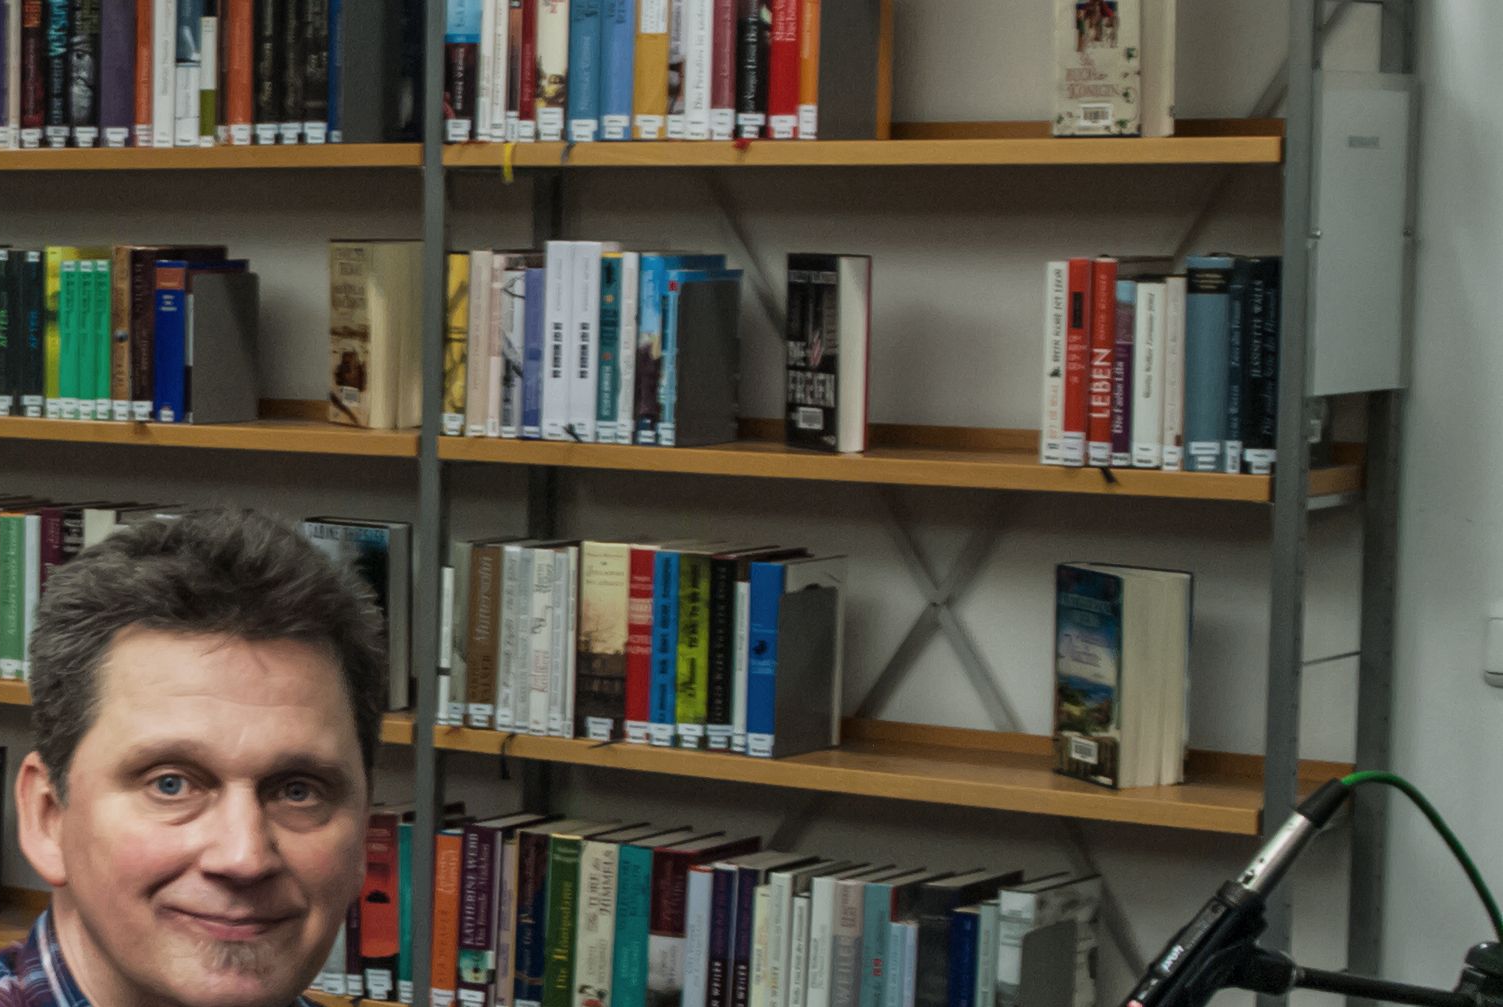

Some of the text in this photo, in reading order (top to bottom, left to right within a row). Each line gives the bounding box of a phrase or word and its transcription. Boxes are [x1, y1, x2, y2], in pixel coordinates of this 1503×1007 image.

[1090, 348, 1112, 418] LEBEN
[1112, 361, 1125, 434] Die Farbe Lila
[475, 555, 494, 641] Muttersohn
[462, 832, 479, 945] KATHERINE WEBB
[555, 967, 568, 989] Die
[712, 960, 722, 996] WEILER
[737, 964, 747, 1000] WEILER
[835, 935, 852, 1006] WEILER
